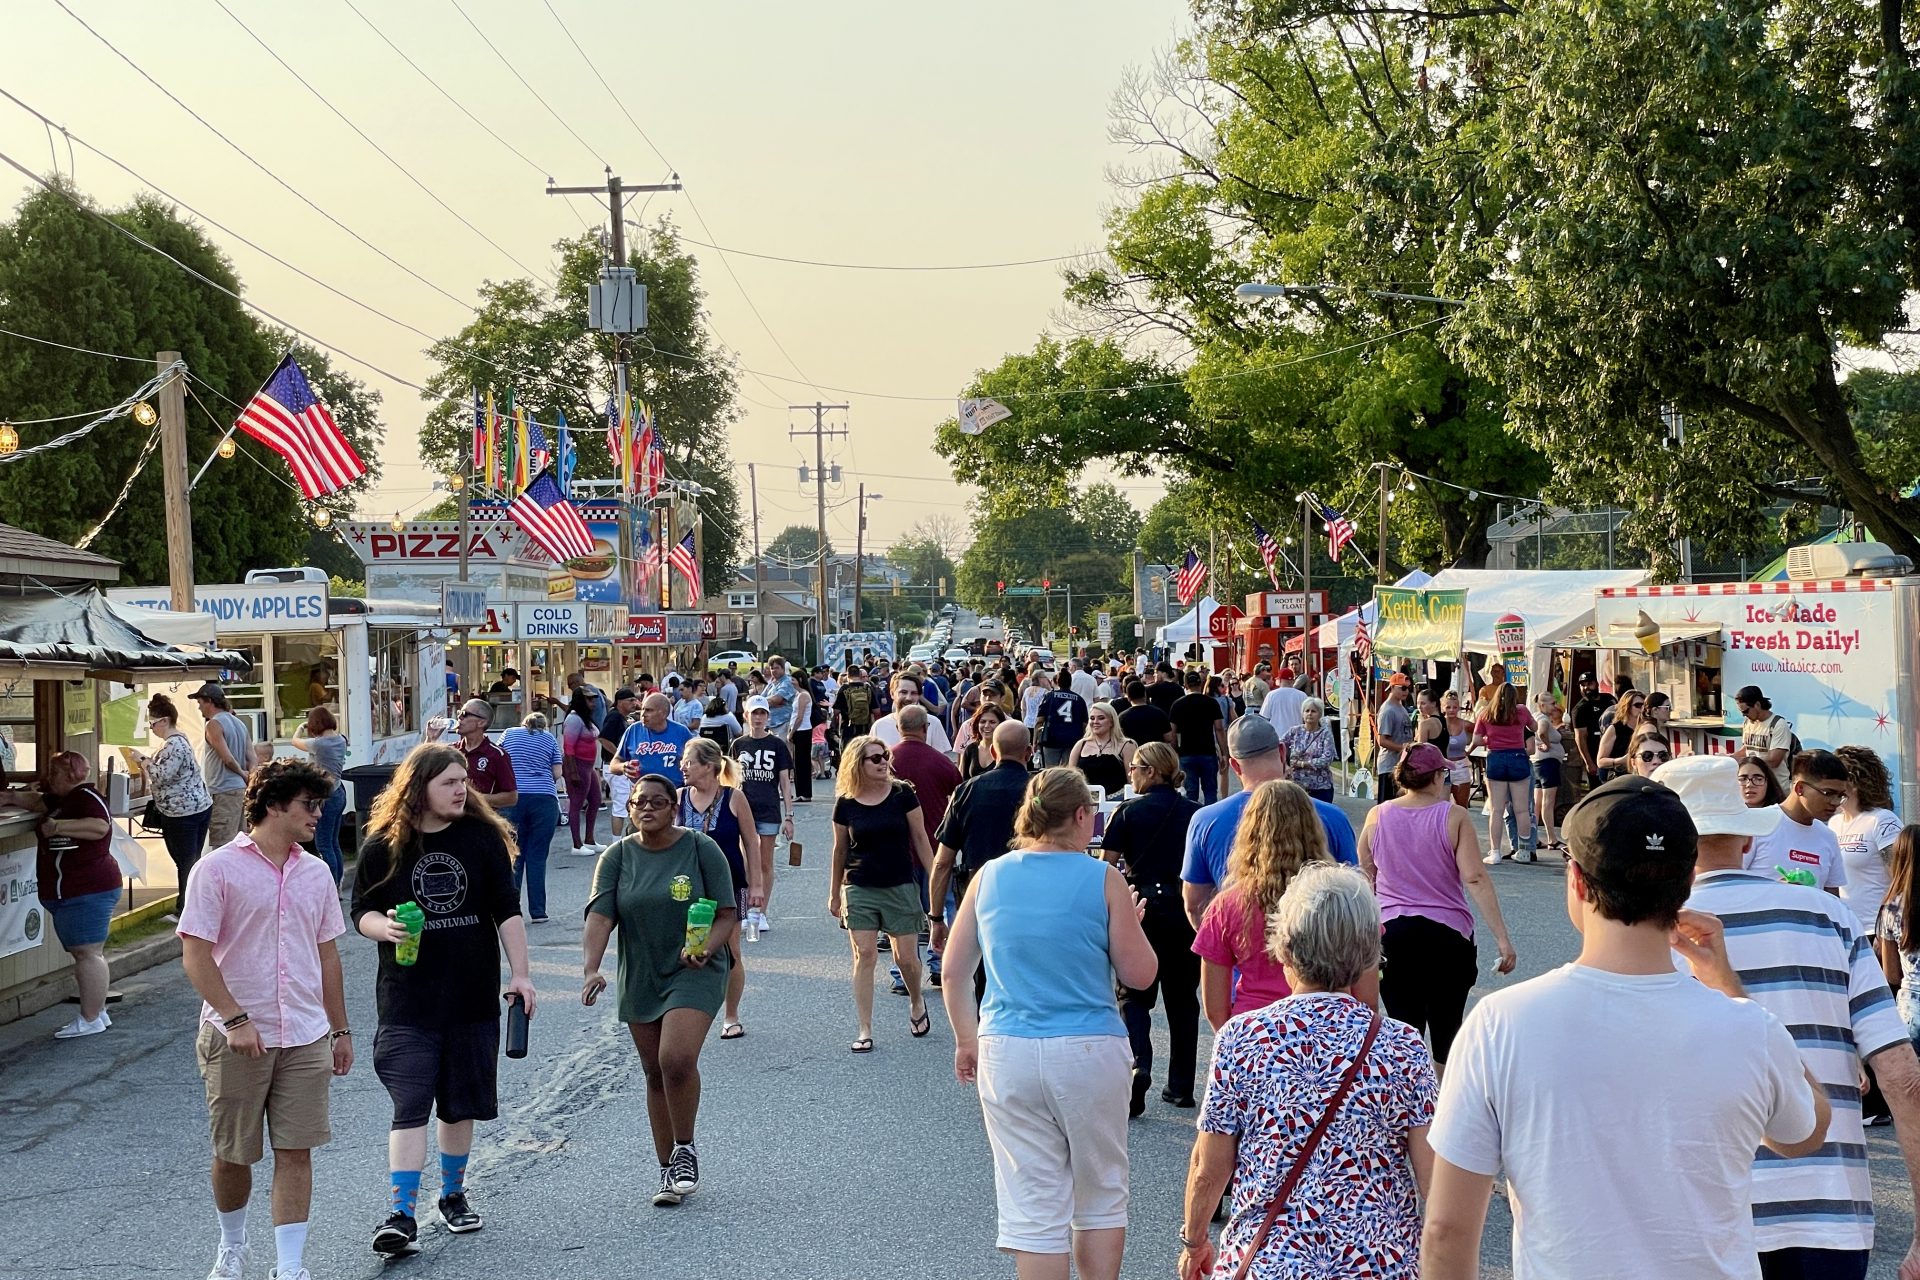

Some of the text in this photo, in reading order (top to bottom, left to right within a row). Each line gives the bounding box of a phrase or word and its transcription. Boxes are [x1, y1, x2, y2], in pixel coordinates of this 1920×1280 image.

[371, 534, 497, 558] PIZZA
[193, 596, 246, 620] ANDY
[252, 595, 322, 619] APPLES
[533, 608, 572, 621] COLD
[1381, 592, 1463, 624] Kettle Corn
[1746, 604, 1776, 623] Ice
[526, 622, 579, 635] DRINKS
[635, 623, 661, 639] Drinks
[1100, 619, 1108, 627] 15
[1731, 629, 1860, 656] Fresh Daily!
[1751, 657, 1844, 674] www.ritasice.com
[1056, 700, 1073, 722] 4
[635, 741, 678, 756] R-Phils
[662, 755, 676, 767] 12
[753, 749, 776, 770] 15
[414, 854, 465, 881] THE KEYSTONE
[426, 899, 460, 912] STATE
[423, 914, 480, 931] NNSYLVANIA
